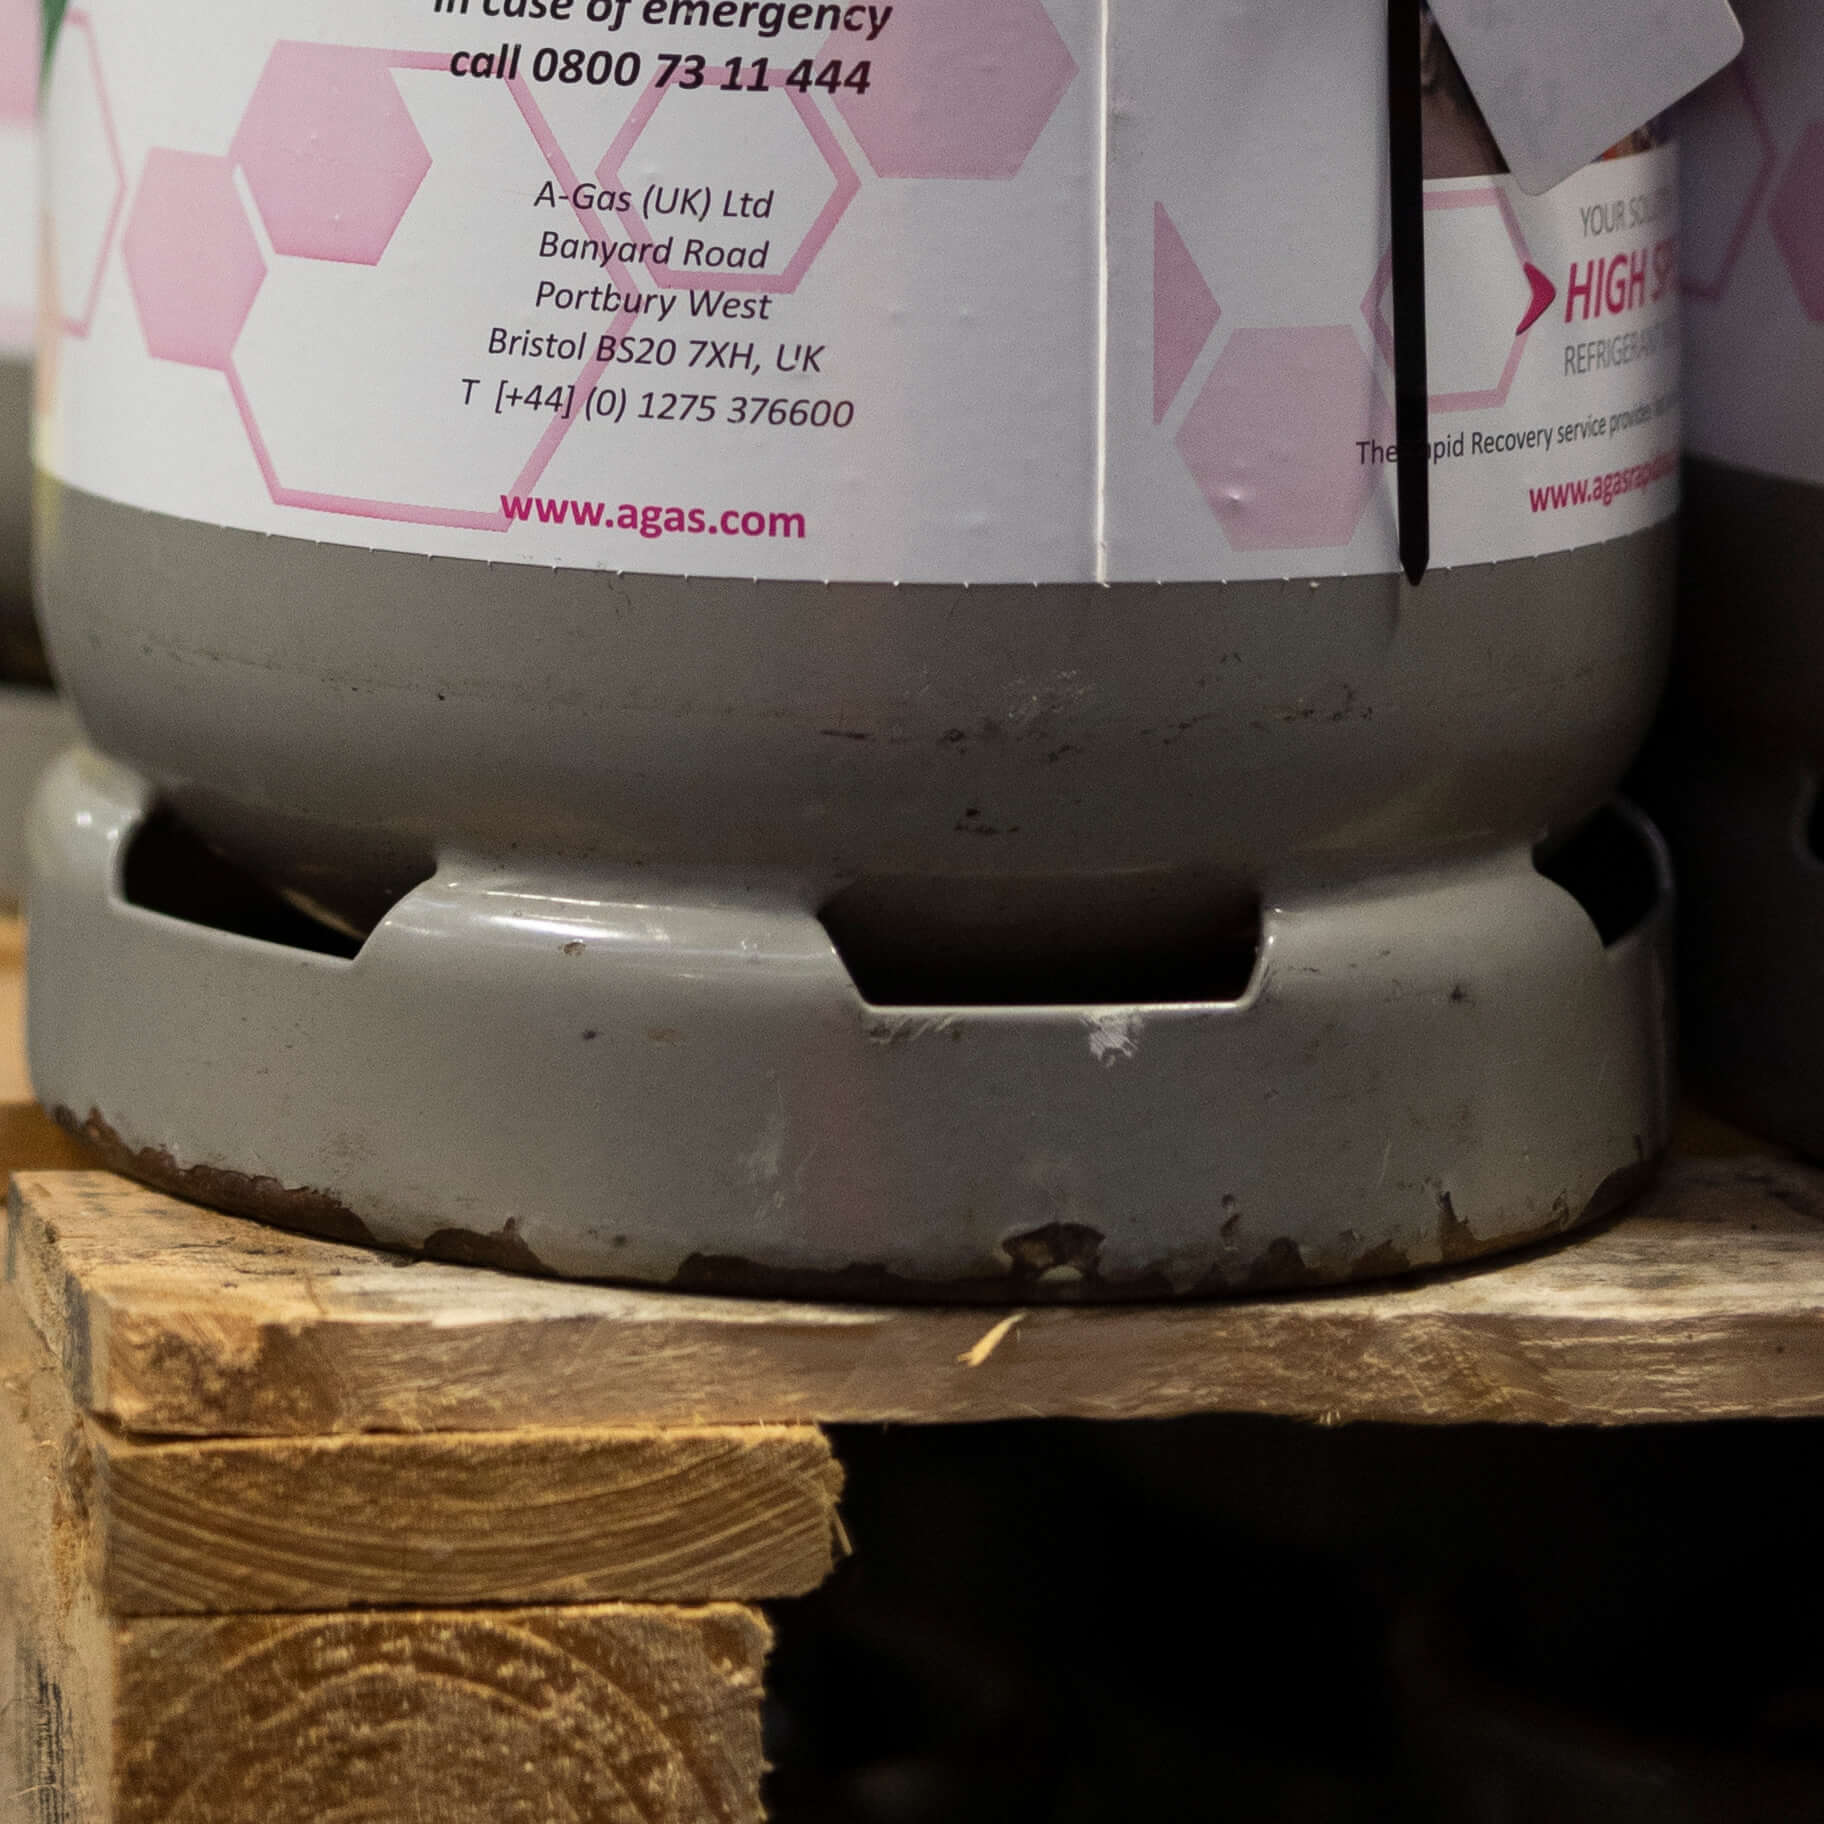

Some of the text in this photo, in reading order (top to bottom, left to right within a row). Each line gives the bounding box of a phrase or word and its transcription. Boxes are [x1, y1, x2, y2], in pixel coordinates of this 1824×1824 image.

[449, 44, 870, 94] call 0800 73 11 444
[534, 181, 774, 221] A-Gas (UK) Ltd
[1580, 202, 1626, 238] YOUR
[539, 231, 769, 270] Banyard Road
[536, 278, 772, 321] Portbury West
[1564, 248, 1647, 324] HIGH
[488, 328, 825, 375] Bristol BS20 7XH, UK
[462, 379, 854, 428] T [+44] (0) 1275 376600
[1356, 440, 1399, 465] The
[1472, 428, 1553, 454] Recovery
[1557, 415, 1607, 444] service
[501, 495, 805, 538] www.agas.com
